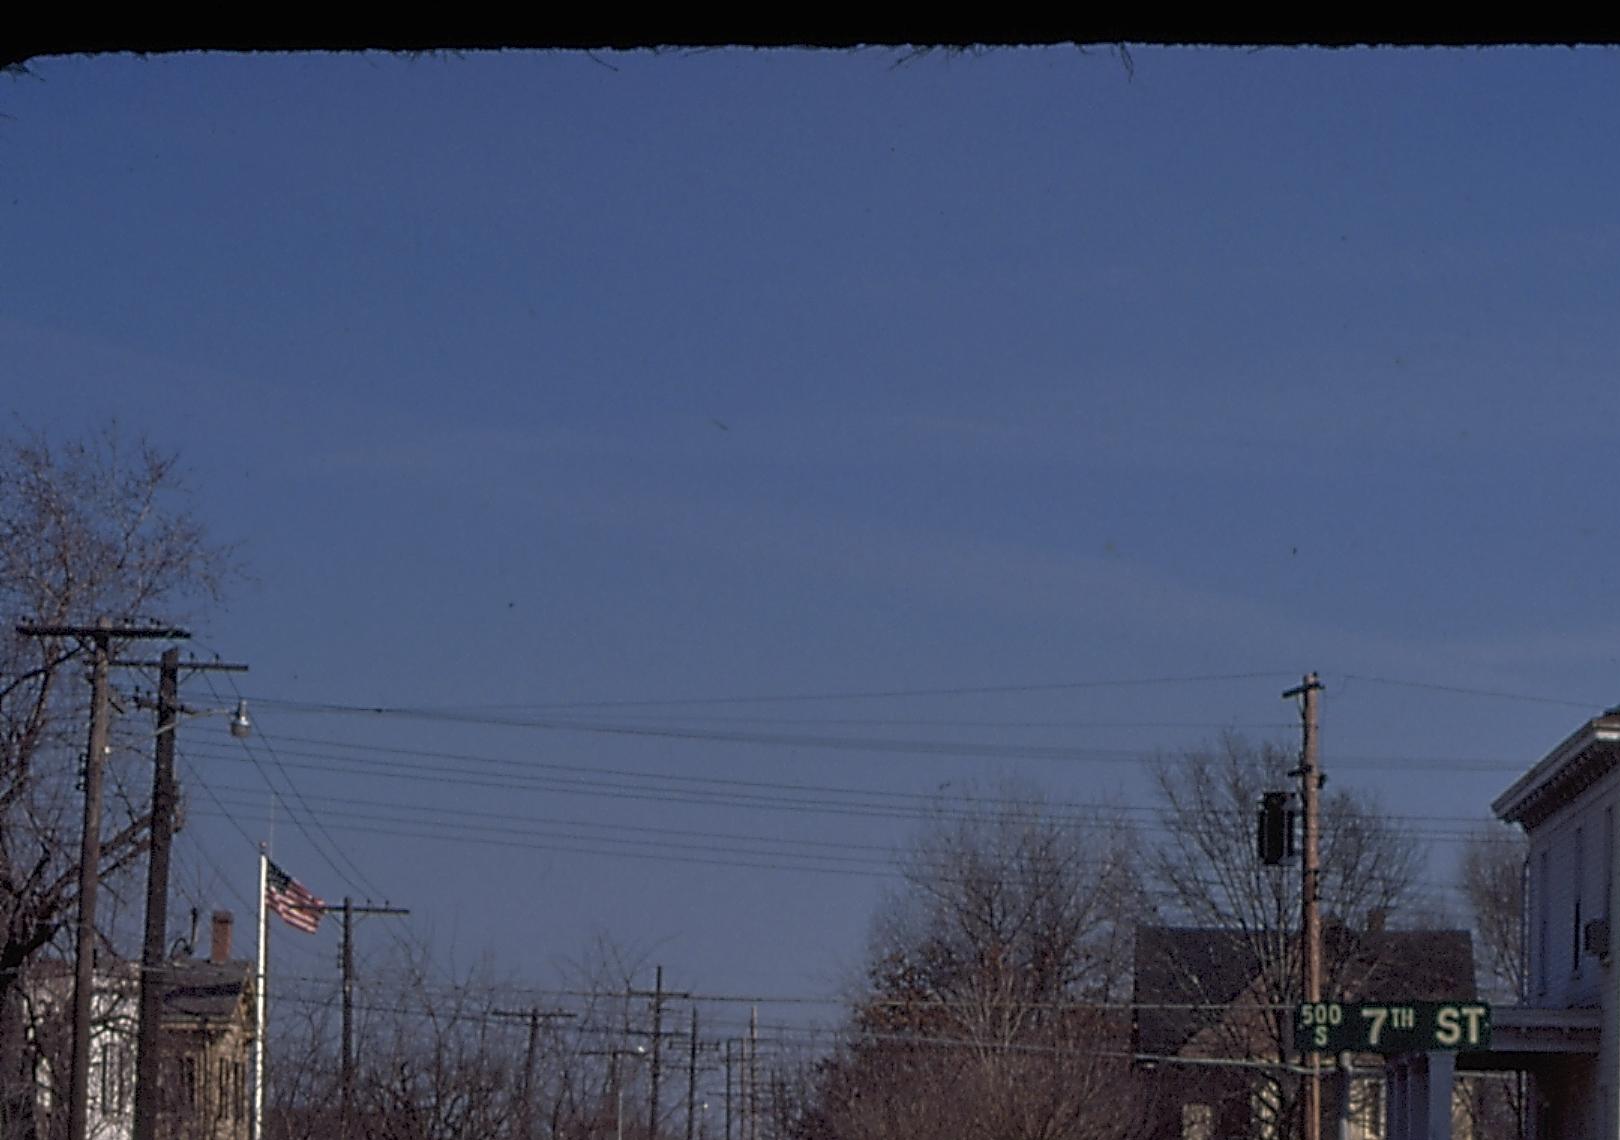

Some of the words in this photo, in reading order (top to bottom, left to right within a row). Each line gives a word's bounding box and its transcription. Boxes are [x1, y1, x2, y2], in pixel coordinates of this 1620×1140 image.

[1302, 1004, 1341, 1025] 500
[1314, 1026, 1328, 1046] S
[1361, 1007, 1414, 1045] 7TH
[1436, 1007, 1486, 1045] ST
